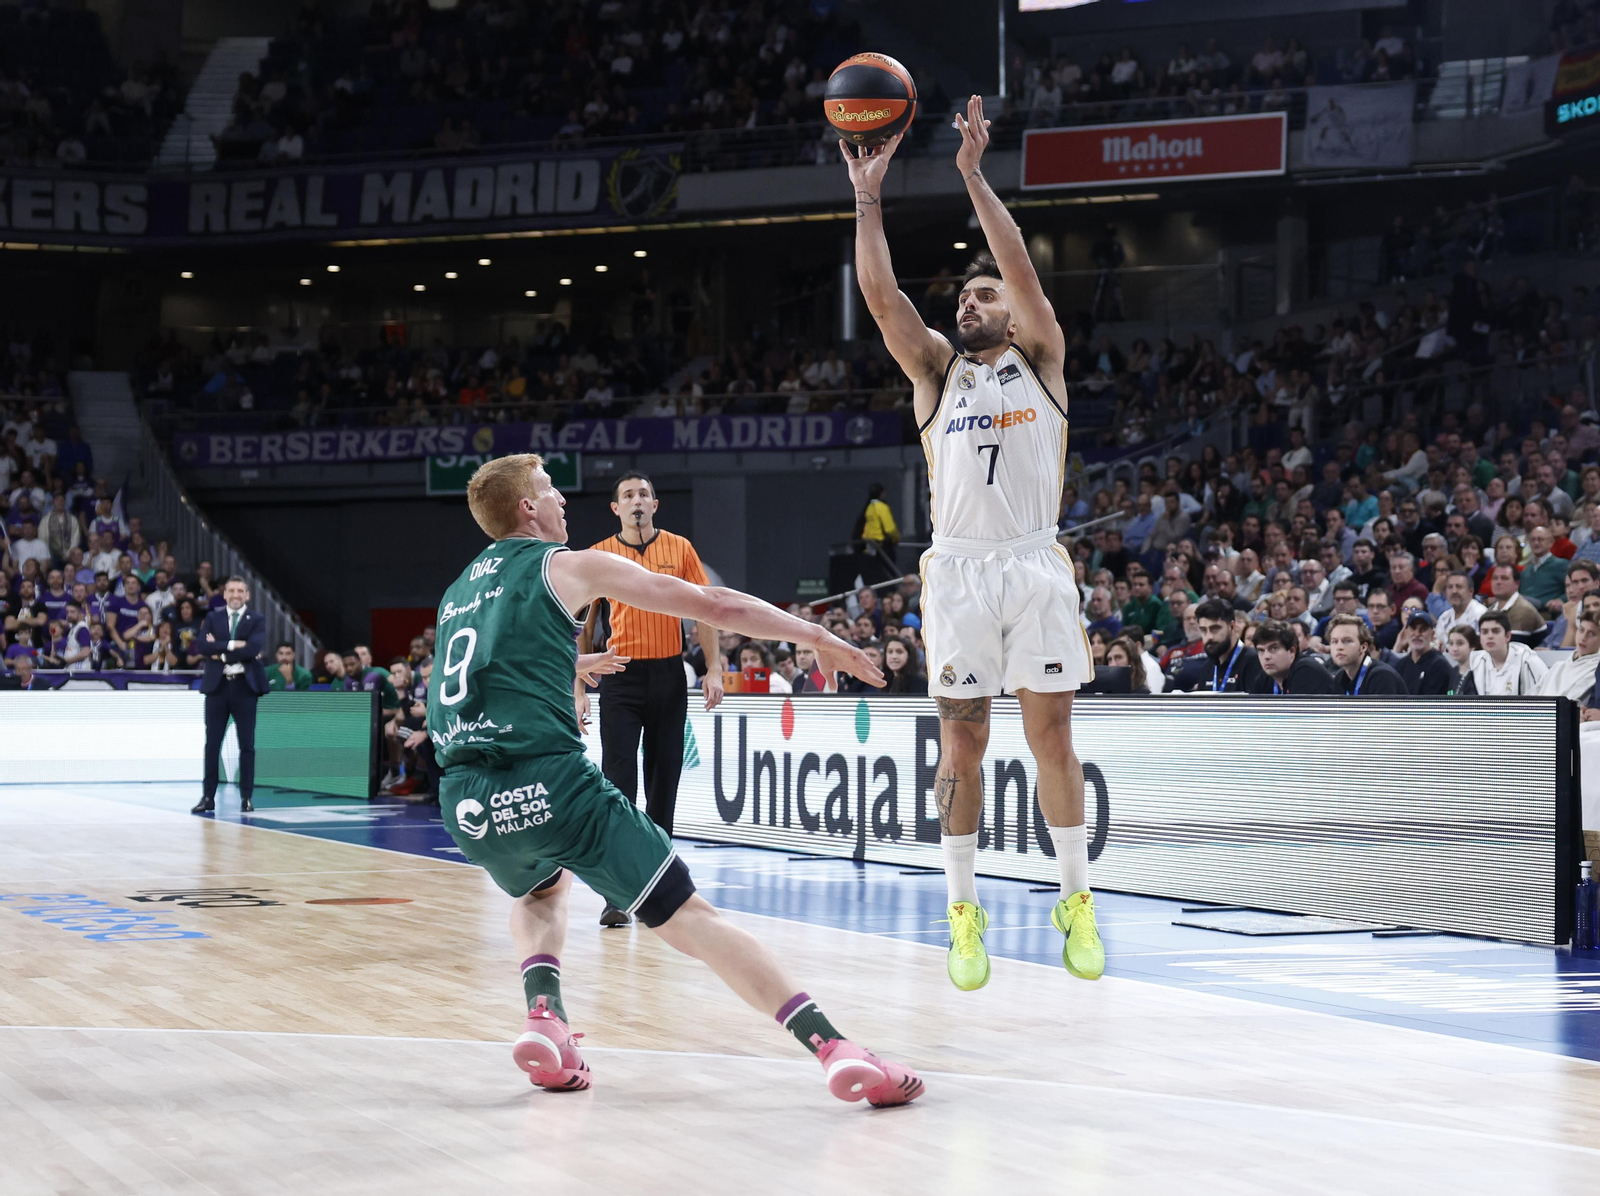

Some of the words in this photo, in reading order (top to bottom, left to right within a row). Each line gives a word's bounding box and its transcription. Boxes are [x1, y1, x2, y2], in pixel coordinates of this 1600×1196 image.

[1102, 133, 1203, 163] Mahou
[188, 176, 338, 233] REAL
[359, 159, 600, 224] MADRID
[946, 408, 1037, 434] AUTOHERO
[208, 426, 467, 464] BERSERKERS
[529, 420, 642, 450] REAL
[672, 415, 833, 450] MADRID
[978, 444, 1000, 485] 7
[469, 557, 503, 582] DÍAZ
[440, 627, 477, 706] 9
[432, 712, 499, 746] Andalucía
[490, 782, 549, 808] COSTA
[714, 698, 903, 860] Unicaja
[915, 715, 1109, 862] Bno
[491, 807, 519, 823] DEL
[520, 798, 551, 815] SOL
[495, 811, 553, 836] MÁLAGA
